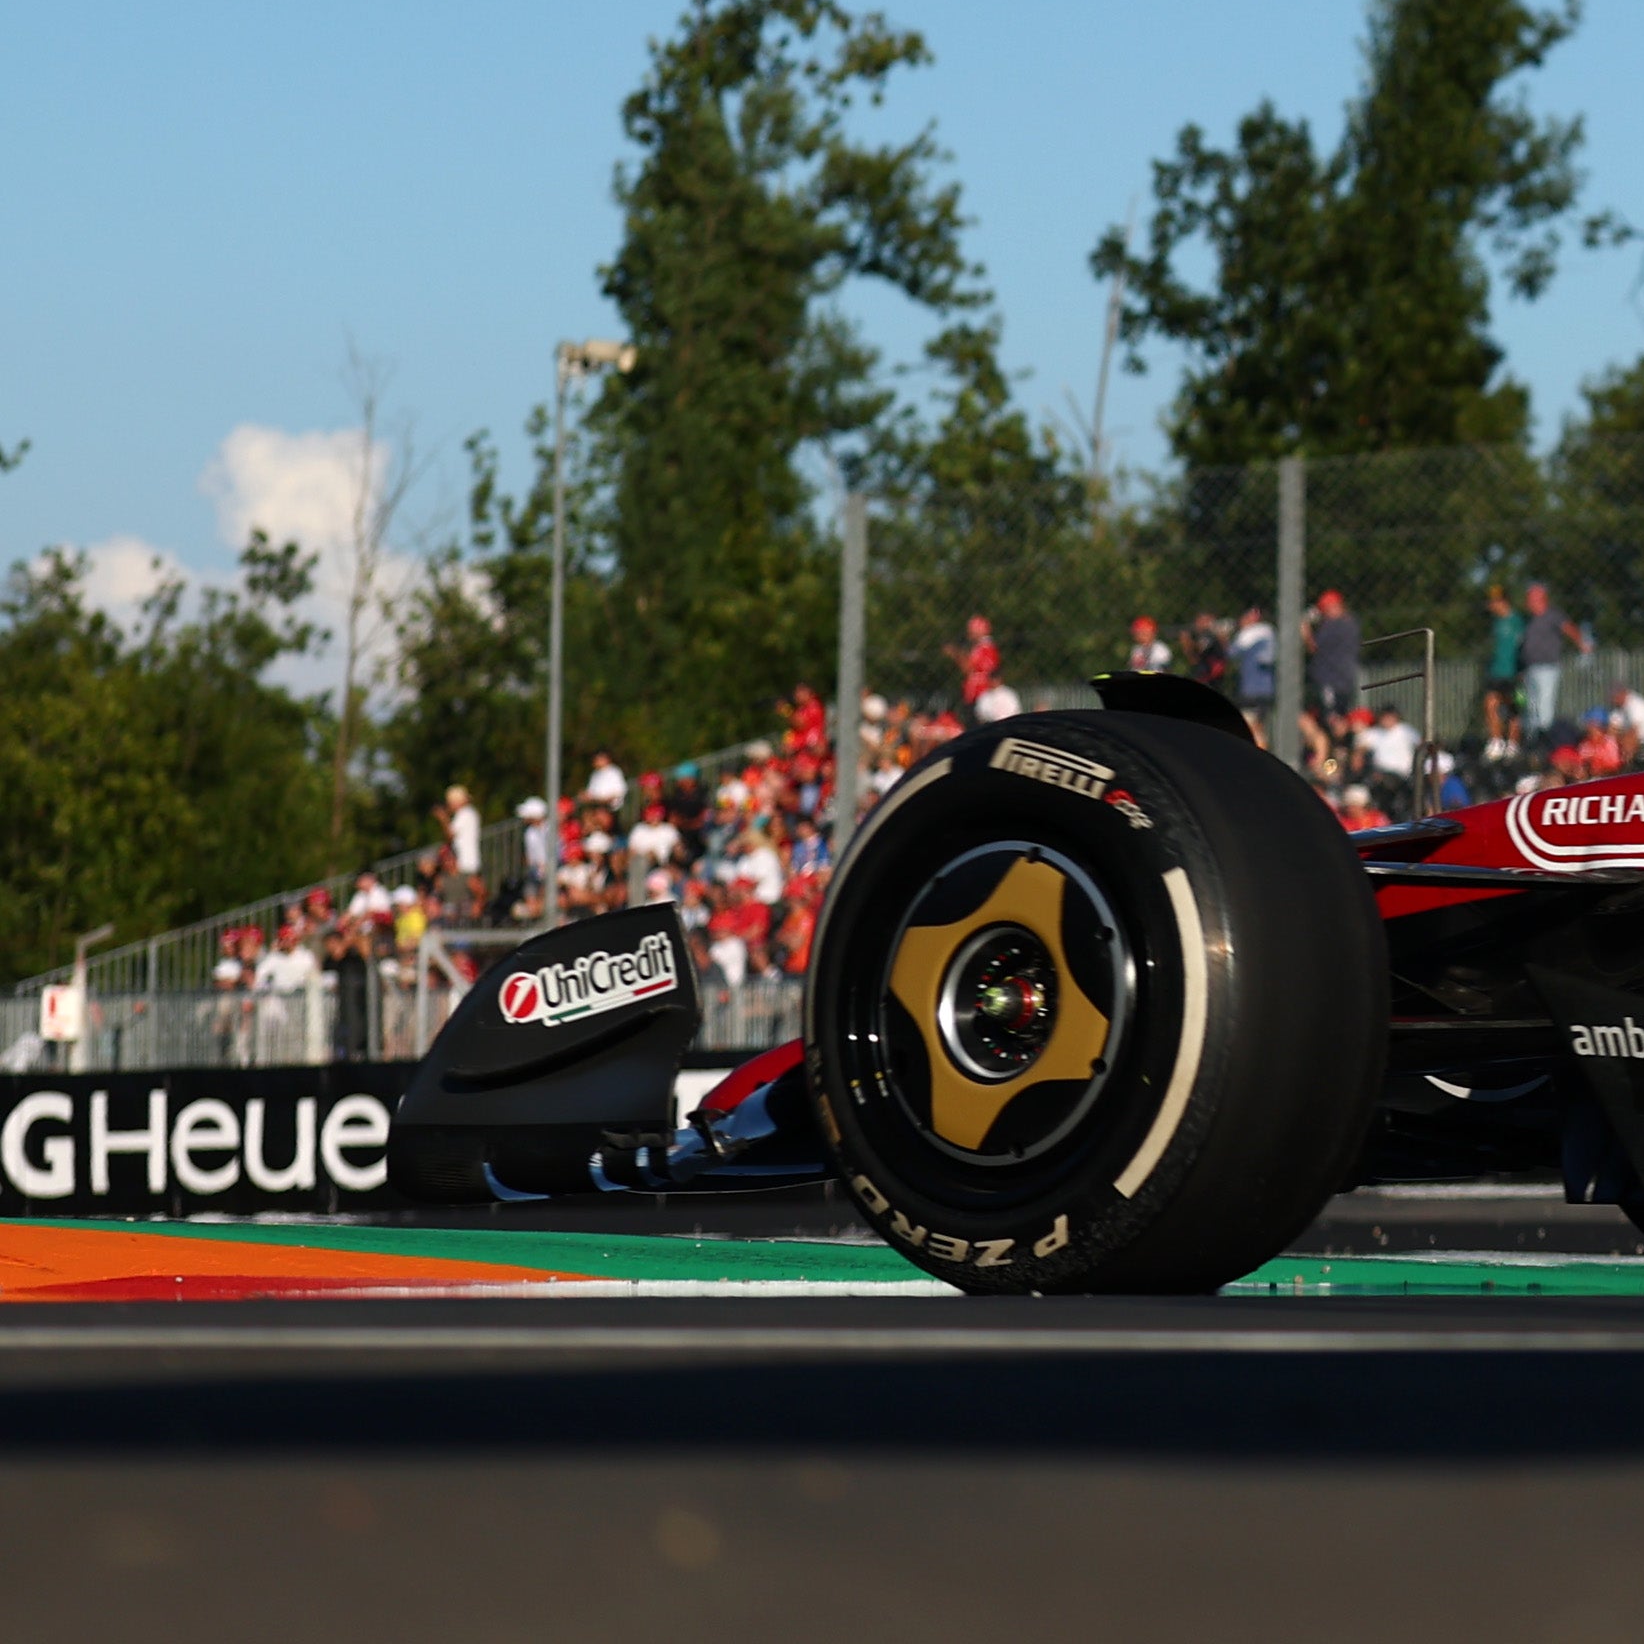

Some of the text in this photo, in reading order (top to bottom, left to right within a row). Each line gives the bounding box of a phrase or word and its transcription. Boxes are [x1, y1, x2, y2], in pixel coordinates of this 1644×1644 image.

[989, 737, 1117, 801] PIRELLI
[541, 940, 671, 1007] UniCredit
[851, 1174, 1069, 1268] P ZERO
